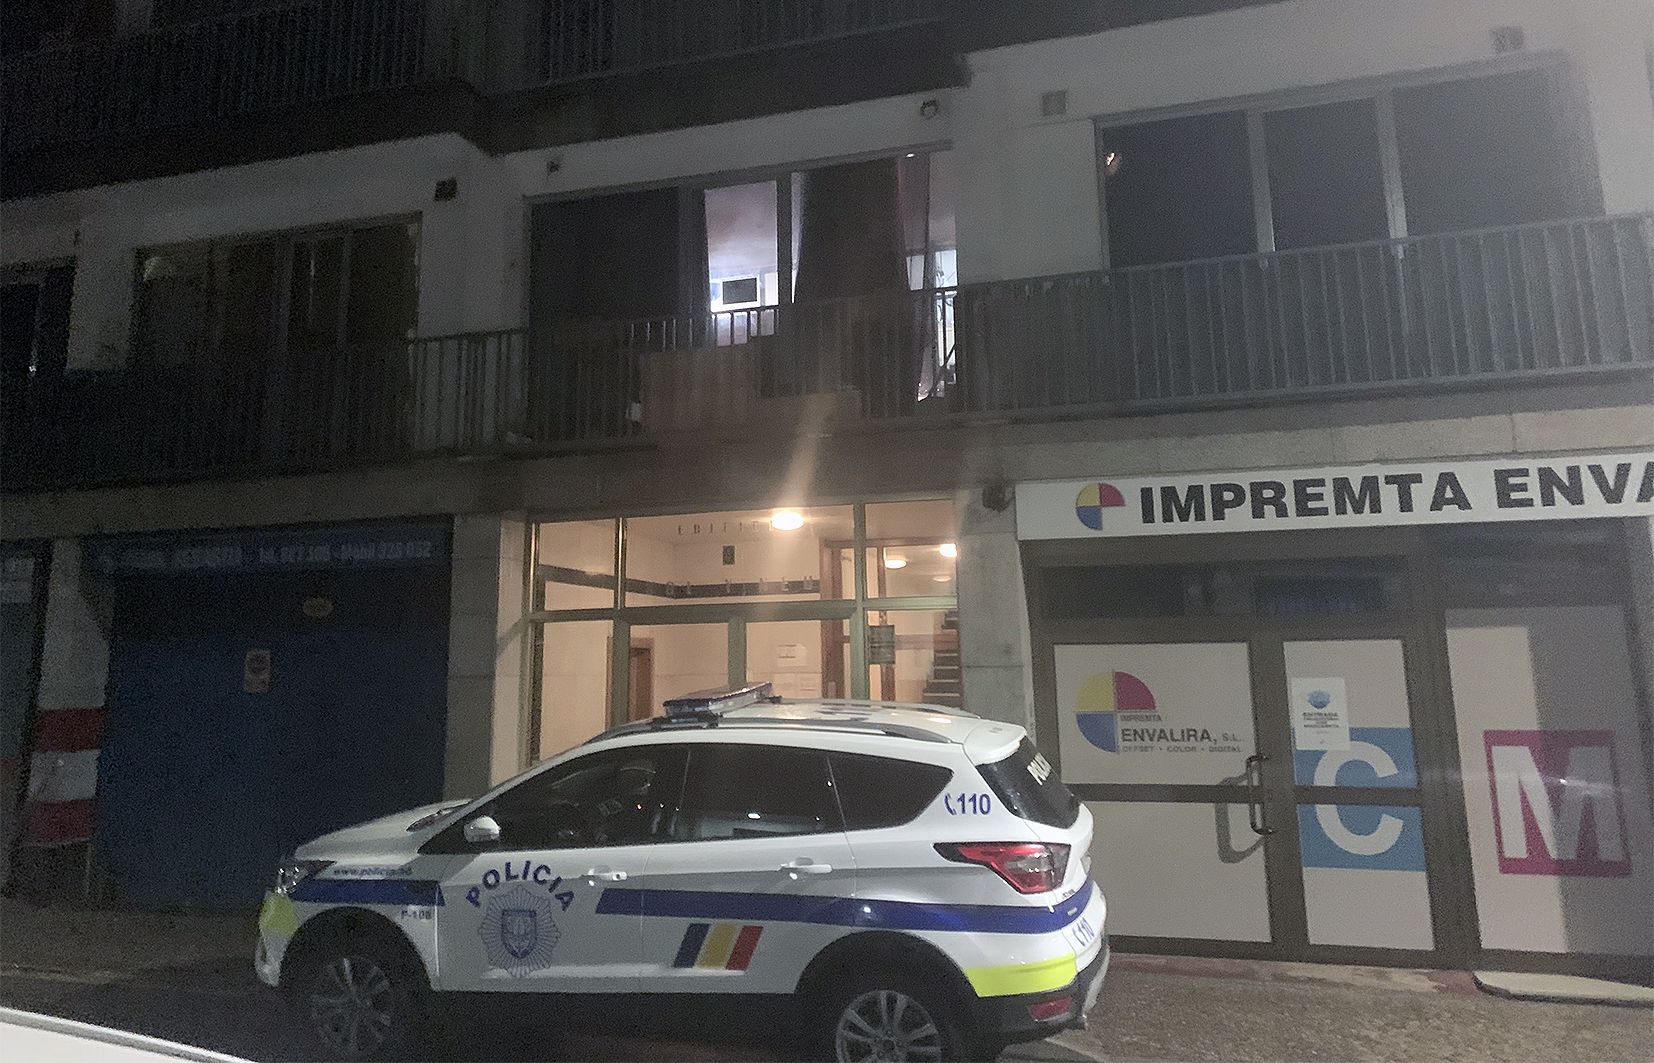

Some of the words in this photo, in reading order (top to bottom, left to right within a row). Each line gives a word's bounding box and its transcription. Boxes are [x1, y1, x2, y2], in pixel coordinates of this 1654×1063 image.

[1140, 471, 1472, 524] IMPREMTA
[1121, 728, 1217, 744] ENVALIRA,
[1166, 745, 1197, 753] COLOR
[957, 792, 991, 815] 110
[1313, 740, 1404, 856] C
[1491, 745, 1625, 862] M
[465, 860, 575, 912] POLICIA
